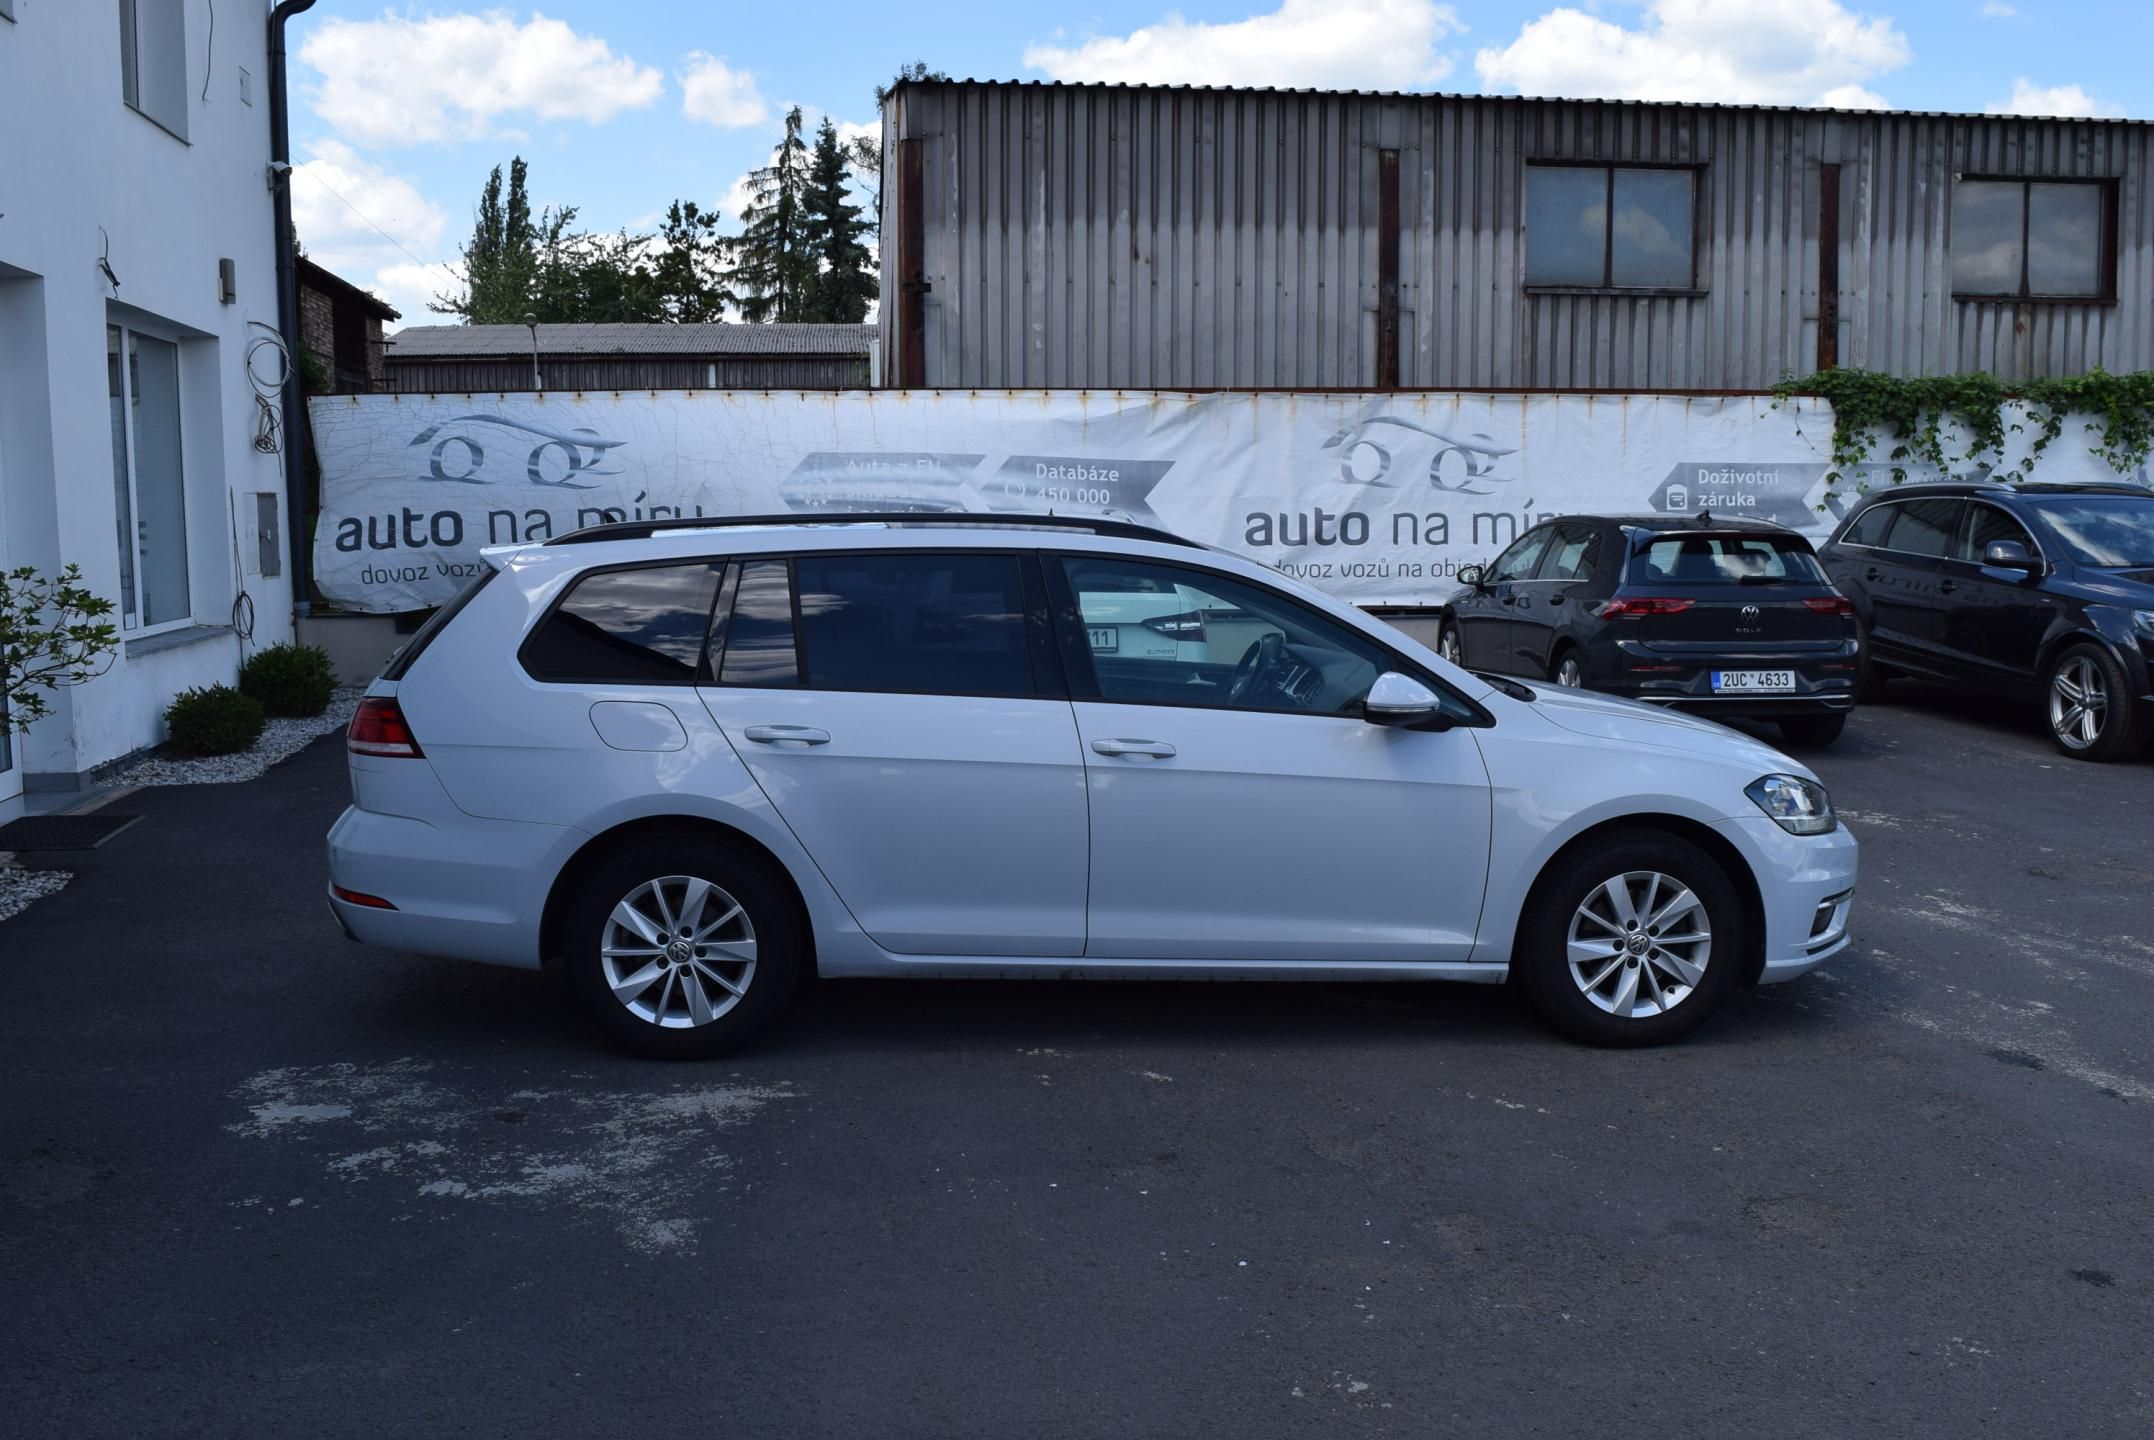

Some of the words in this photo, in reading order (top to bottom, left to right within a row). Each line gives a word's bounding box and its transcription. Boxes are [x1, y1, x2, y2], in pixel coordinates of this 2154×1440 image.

[1036, 463, 1120, 482] Databáze
[1698, 468, 1780, 484] Doživotní
[1077, 488, 1110, 504] 000
[1698, 491, 1756, 506] záruka
[335, 507, 463, 552] auto
[488, 508, 553, 545] na
[1244, 506, 1370, 547] auto
[1392, 512, 1449, 546] na
[361, 563, 430, 585] dovoz
[1340, 557, 1390, 578] vozů
[1398, 563, 1422, 577] na
[1723, 673, 1748, 687] 2UC
[1757, 673, 1789, 687] 4633
